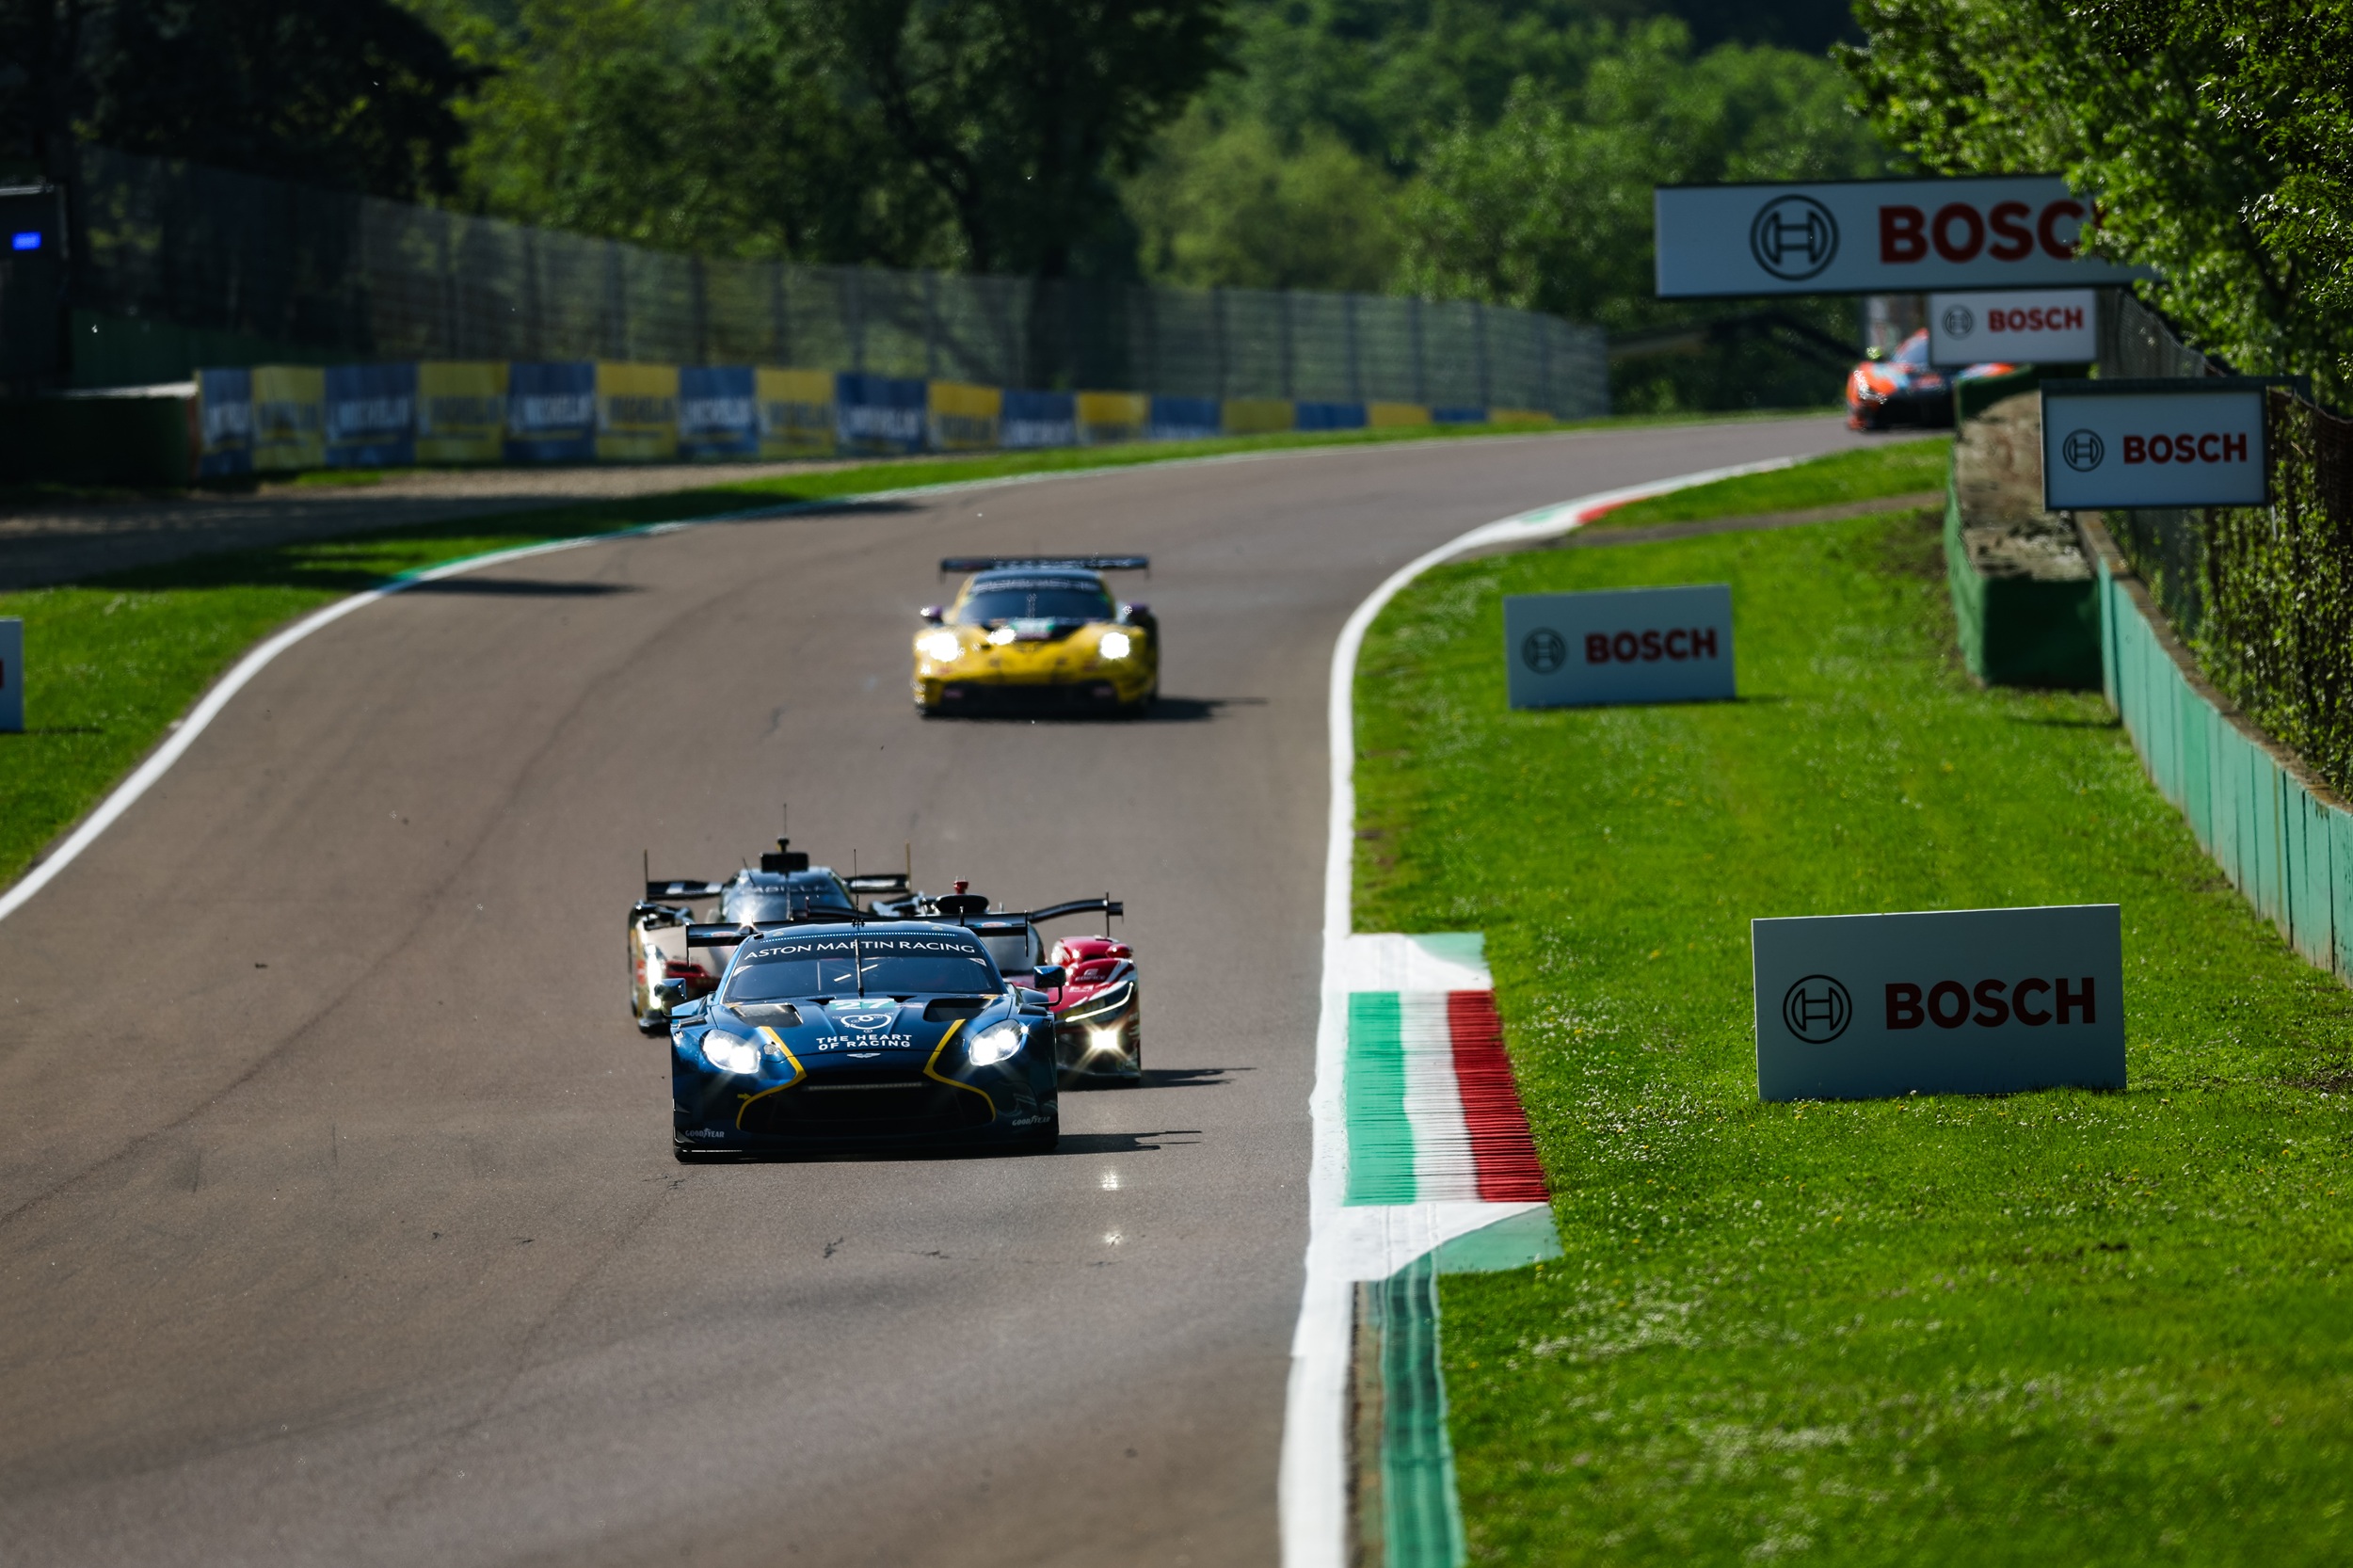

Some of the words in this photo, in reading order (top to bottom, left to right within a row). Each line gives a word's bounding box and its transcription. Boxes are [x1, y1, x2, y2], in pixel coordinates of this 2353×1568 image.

[1988, 307, 2084, 332] BOSCH
[2122, 433, 2248, 465] BOSCH
[1585, 628, 1718, 664] BOSCH
[744, 944, 811, 960] ASTON
[817, 941, 894, 952] MARTIN
[899, 941, 975, 953] RACING
[834, 1000, 890, 1010] 27
[1885, 977, 2096, 1031] BOSCH
[816, 1035, 849, 1044] THE
[818, 1042, 840, 1051] OF
